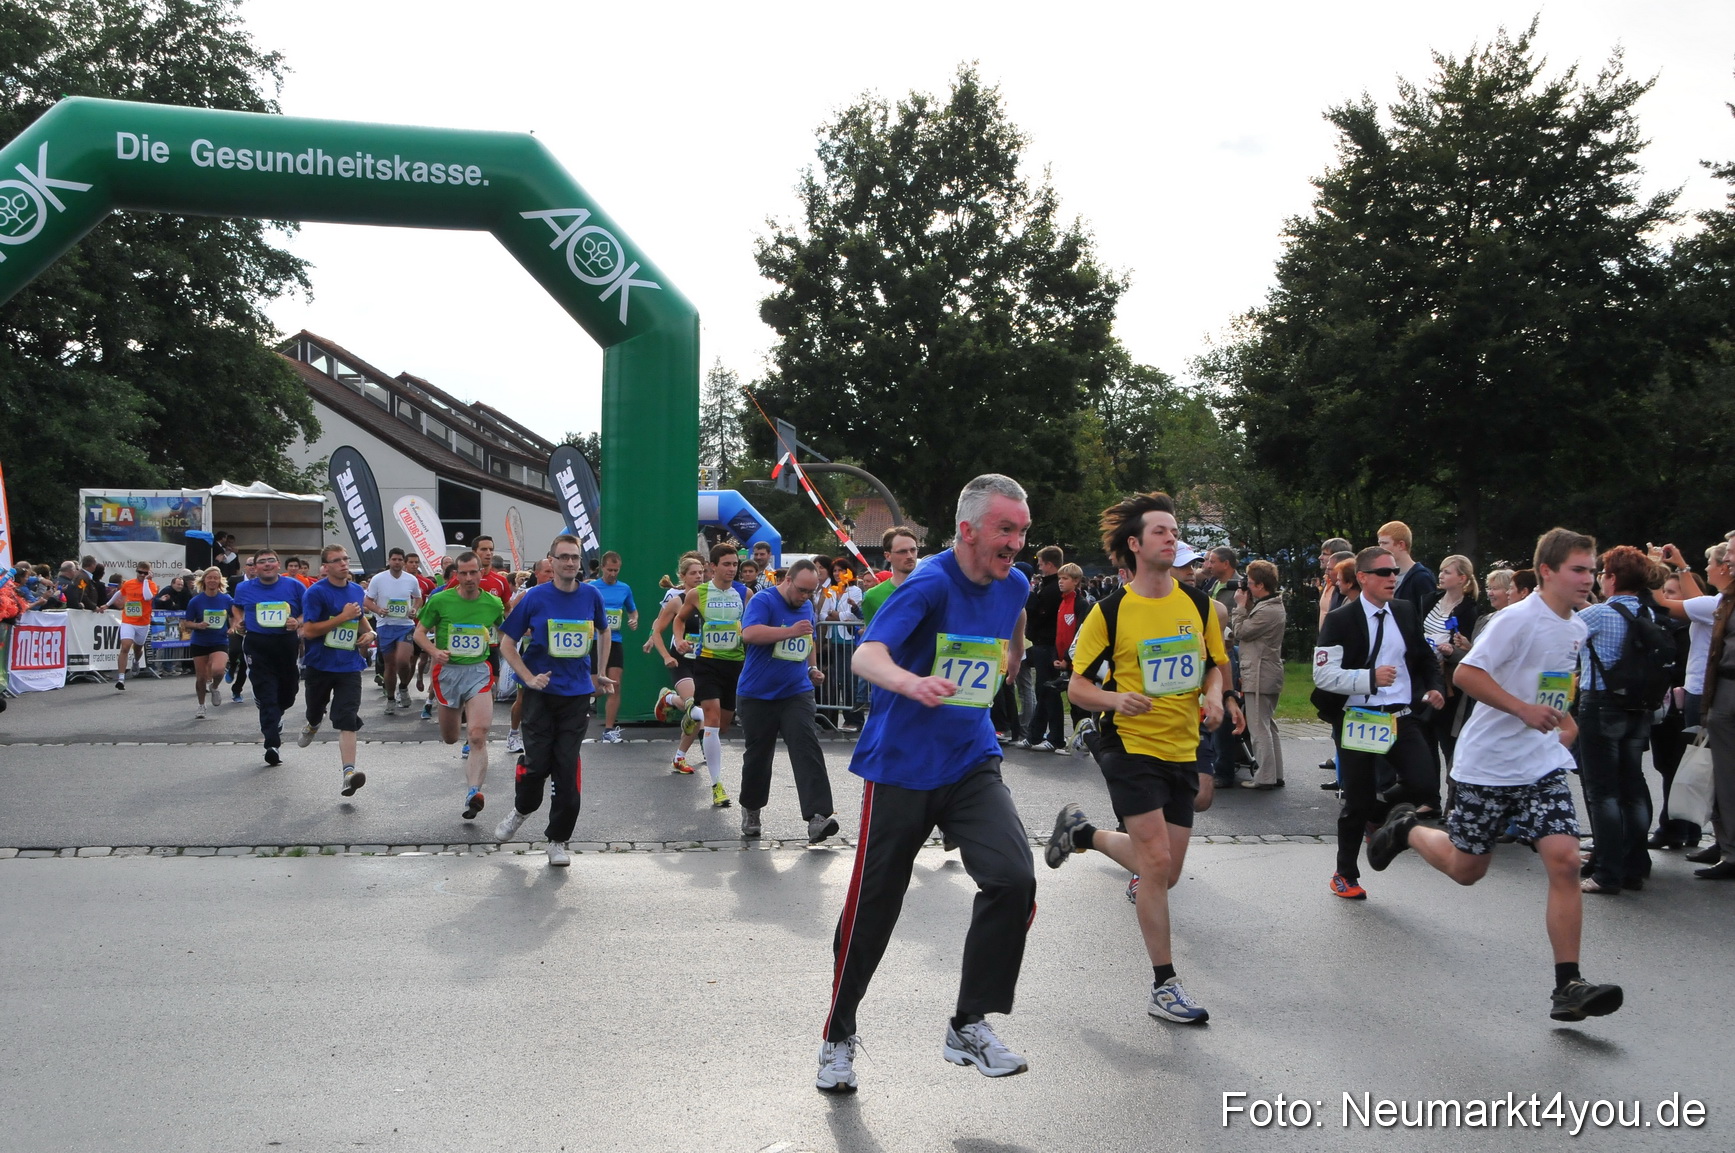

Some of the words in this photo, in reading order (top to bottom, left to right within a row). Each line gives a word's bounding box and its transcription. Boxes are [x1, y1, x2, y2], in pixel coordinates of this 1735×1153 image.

[116, 131, 170, 164] Die
[190, 138, 490, 187] Gesundheitskasse.
[0, 140, 94, 263] OK
[519, 208, 662, 326] AOK
[90, 507, 134, 522] TLA
[140, 514, 191, 529] Logistics
[126, 606, 140, 614] 560
[260, 610, 282, 621] 171
[389, 605, 406, 613] 998
[208, 616, 221, 624] 88
[331, 628, 354, 642] 109
[705, 631, 737, 644] 1047
[1178, 625, 1192, 635] FC
[451, 635, 480, 649] 833
[553, 632, 583, 648] 163
[15, 630, 62, 667] MEIER
[941, 658, 990, 690] 172
[1147, 654, 1194, 683] 778
[1346, 721, 1390, 743] 1112
